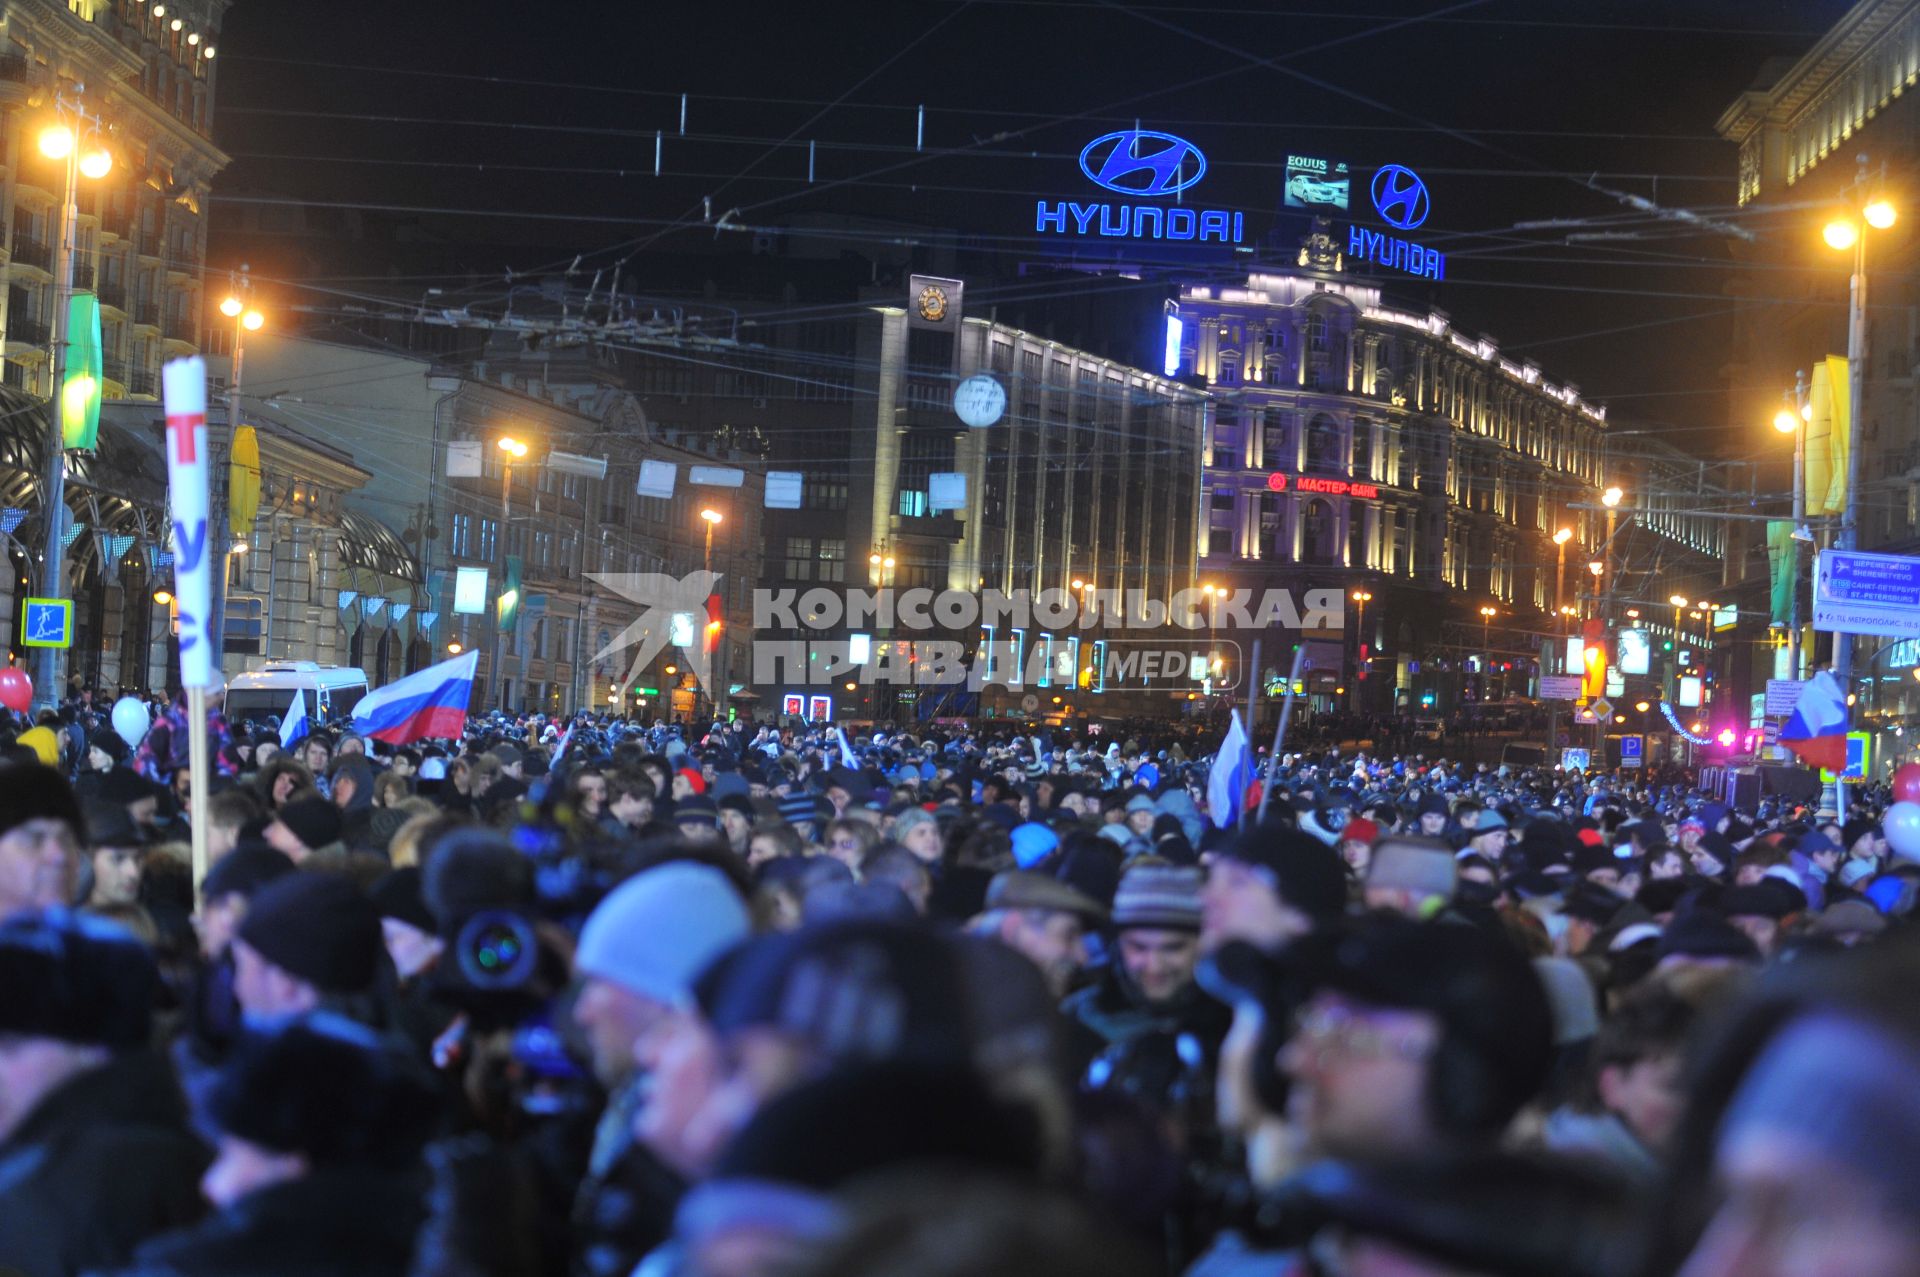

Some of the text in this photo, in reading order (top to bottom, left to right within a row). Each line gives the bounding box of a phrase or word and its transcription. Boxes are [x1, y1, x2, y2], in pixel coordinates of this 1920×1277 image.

[1287, 155, 1327, 170] EQUUS
[1036, 201, 1243, 243] HYUNDAI
[1348, 225, 1445, 280] HYUNDAI
[1848, 617, 1902, 627] МЕТРОПОЛИС
